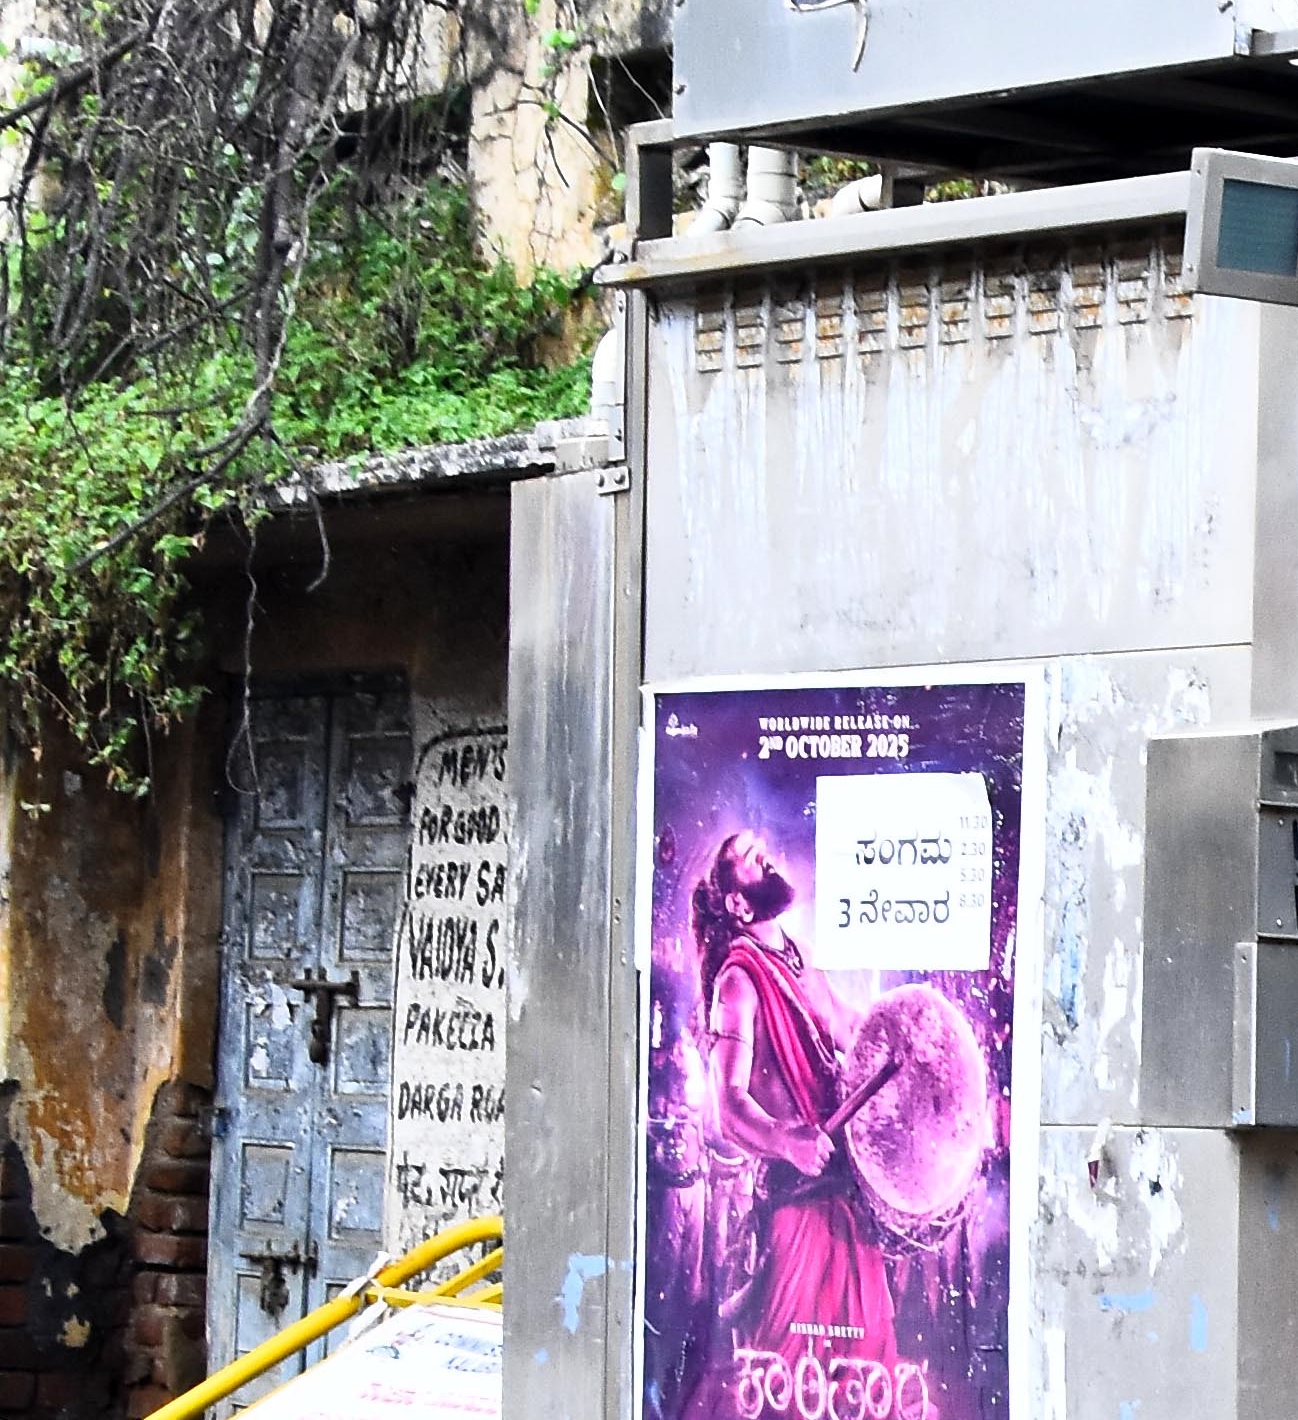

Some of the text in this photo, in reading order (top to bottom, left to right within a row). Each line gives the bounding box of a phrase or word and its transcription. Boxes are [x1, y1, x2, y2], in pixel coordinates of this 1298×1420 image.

[758, 716, 831, 731] WORLDWIDE
[834, 714, 889, 730] RELEASE
[785, 735, 863, 759] OCTOBER
[866, 733, 910, 759] 2025
[856, 830, 953, 866] ಸಂಗಮ
[838, 898, 851, 928] 3
[398, 1080, 464, 1123] DARGA
